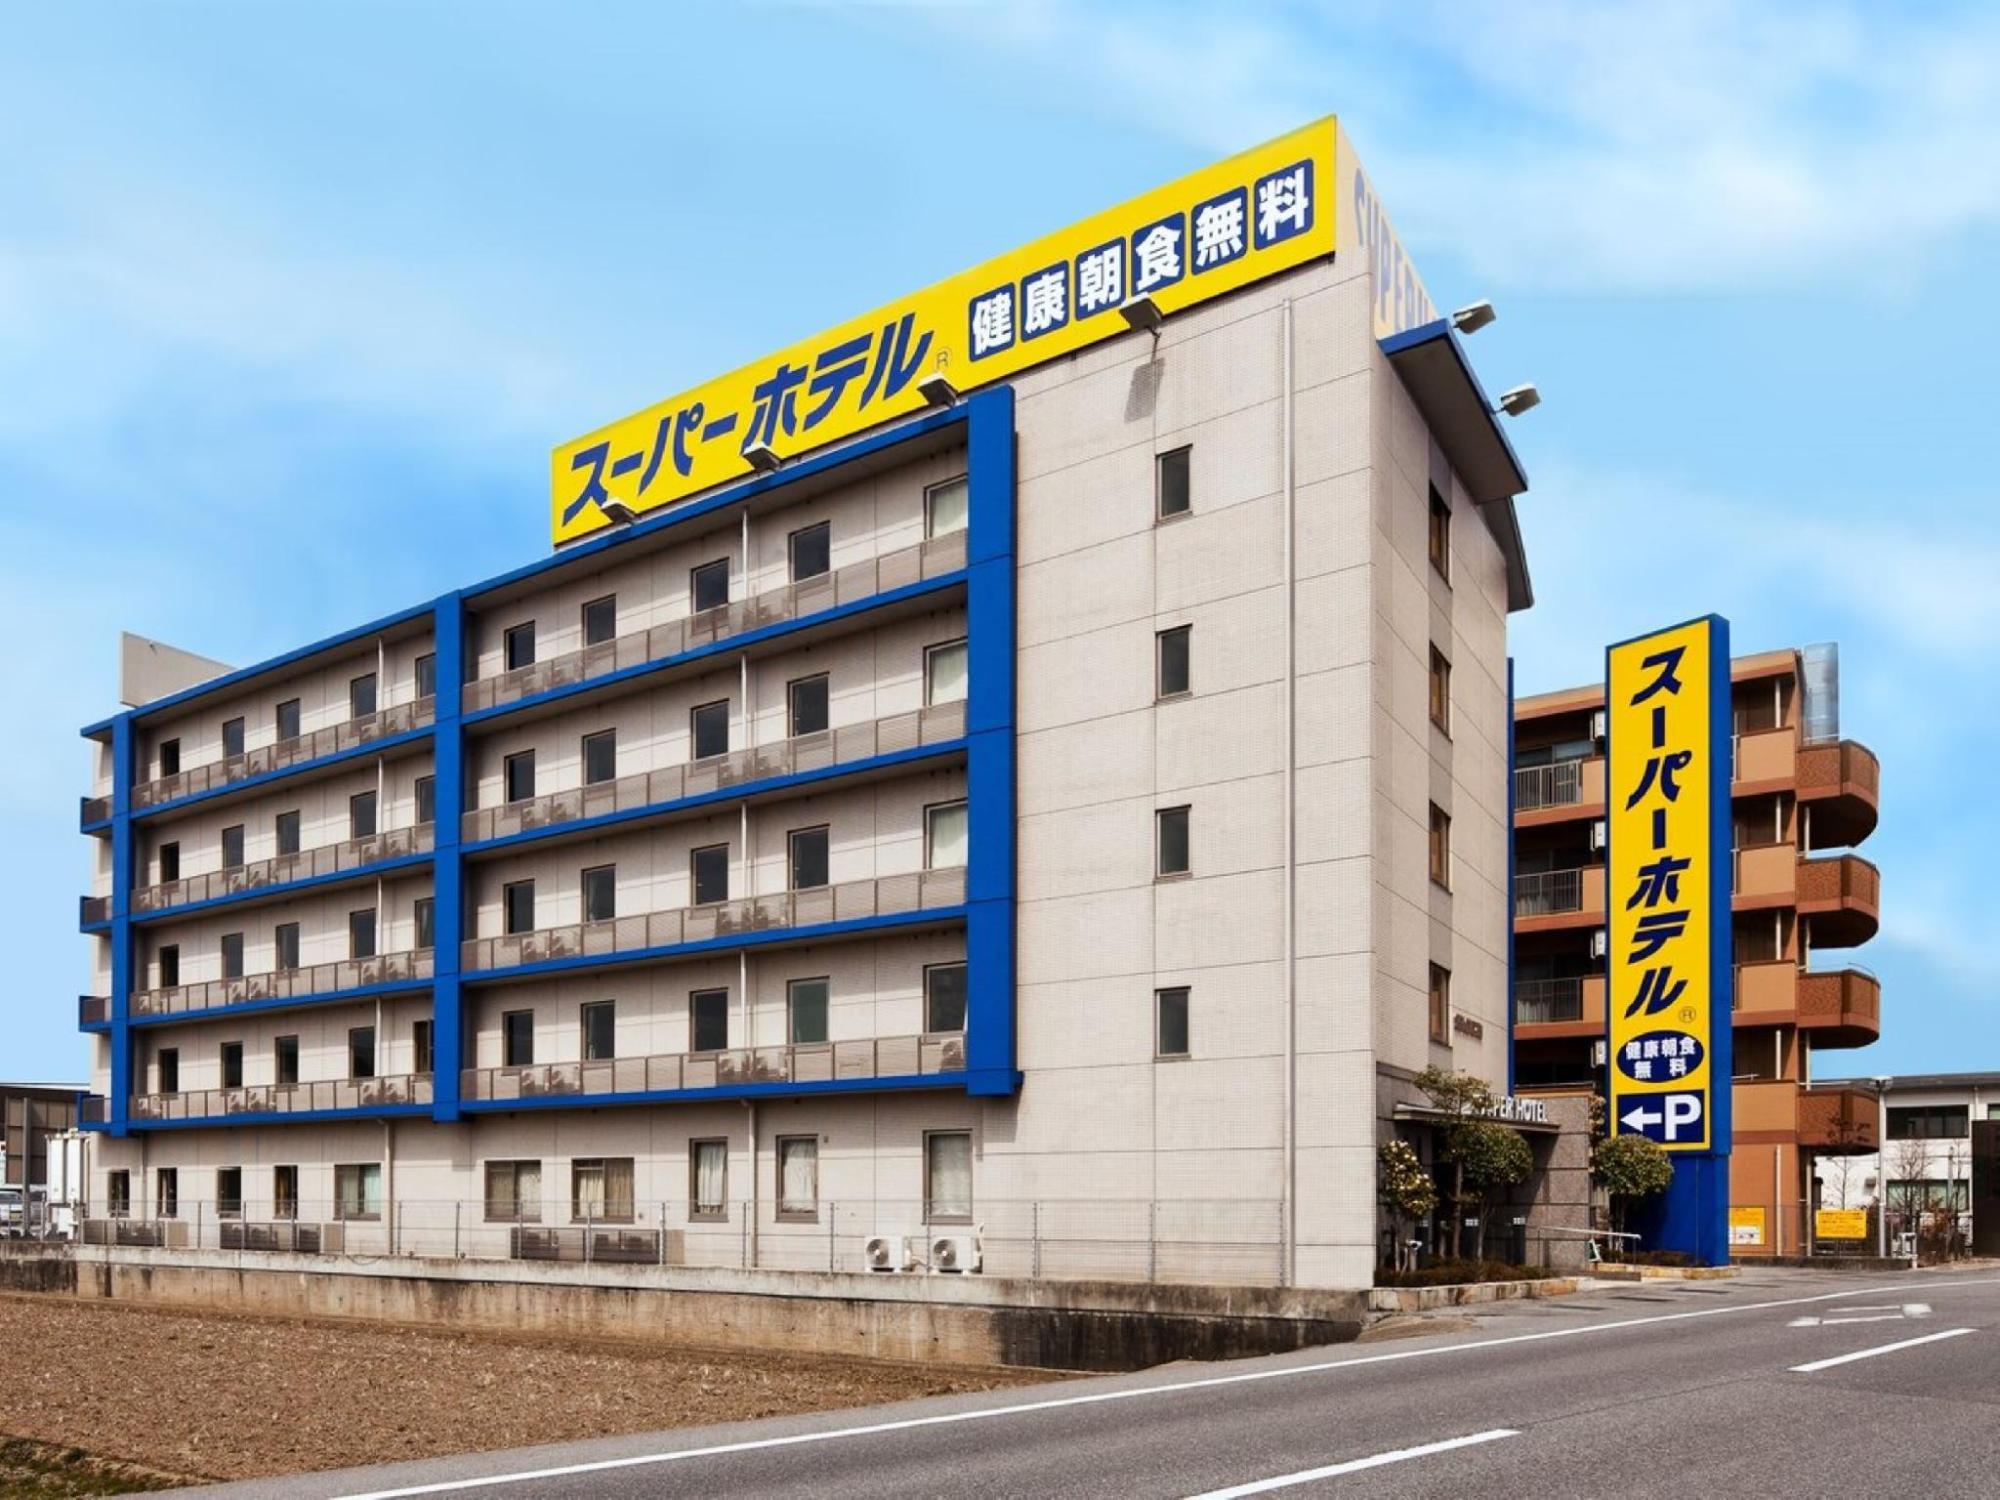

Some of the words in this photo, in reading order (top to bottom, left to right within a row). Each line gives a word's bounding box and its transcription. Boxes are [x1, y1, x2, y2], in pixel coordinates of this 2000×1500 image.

[972, 167, 1310, 357] 健康朝食無料
[562, 312, 935, 528] スーパーホテル
[1624, 645, 1693, 1020] スーパーホテル
[1625, 1036, 1696, 1060] 健康朝食
[1516, 1098, 1548, 1122] HOTEL
[1664, 1094, 1702, 1141] P
